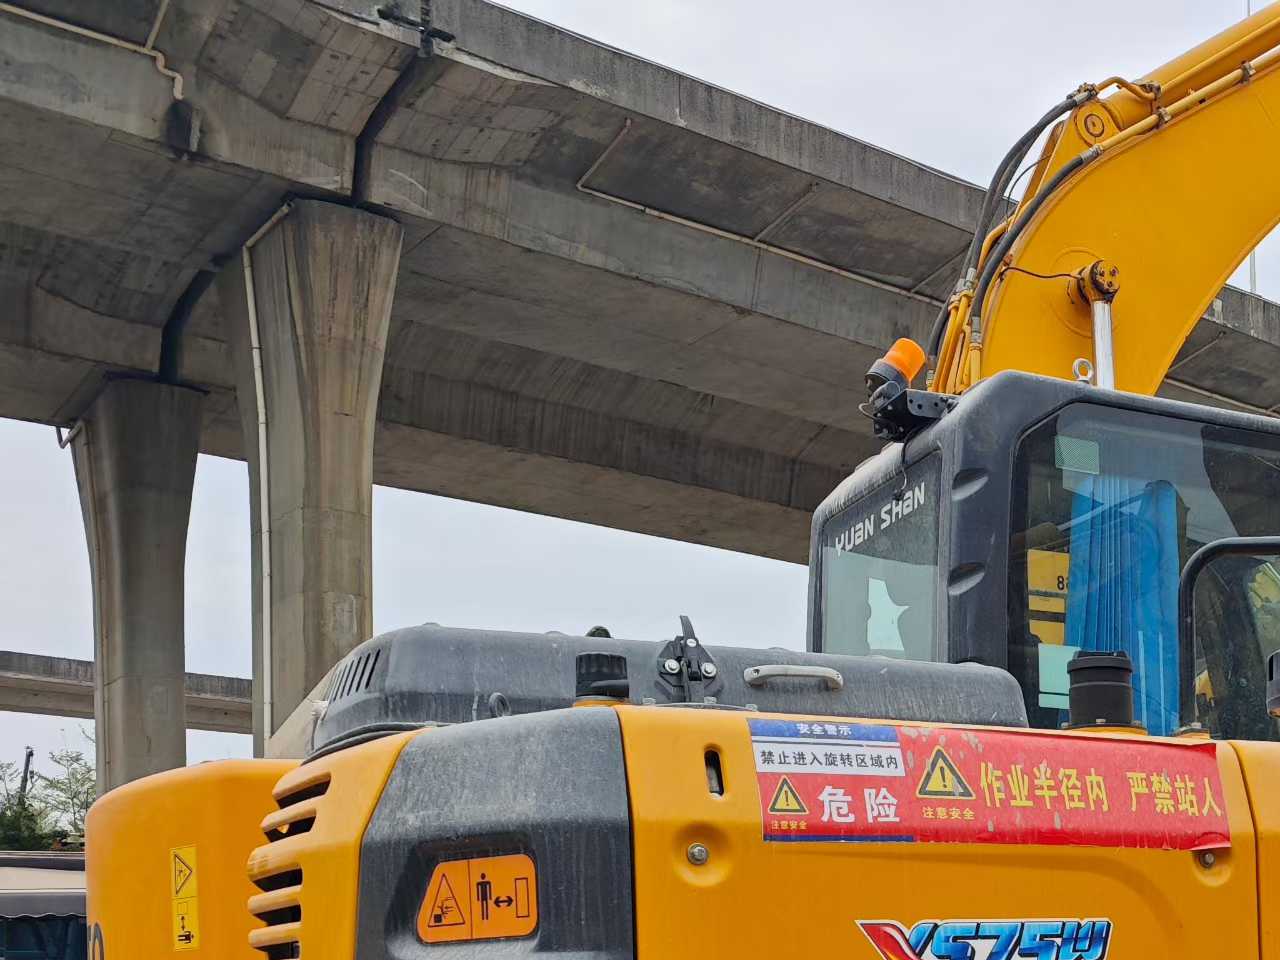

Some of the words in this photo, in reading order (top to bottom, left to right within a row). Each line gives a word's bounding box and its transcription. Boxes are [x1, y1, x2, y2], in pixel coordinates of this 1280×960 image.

[796, 722, 852, 737] 安全警示
[760, 749, 899, 769] 禁止进入旋转区域内
[980, 761, 1110, 813] 作业半径内
[1125, 770, 1223, 817] 严禁站人
[817, 784, 900, 824] 危险
[921, 804, 977, 821] 注意安全
